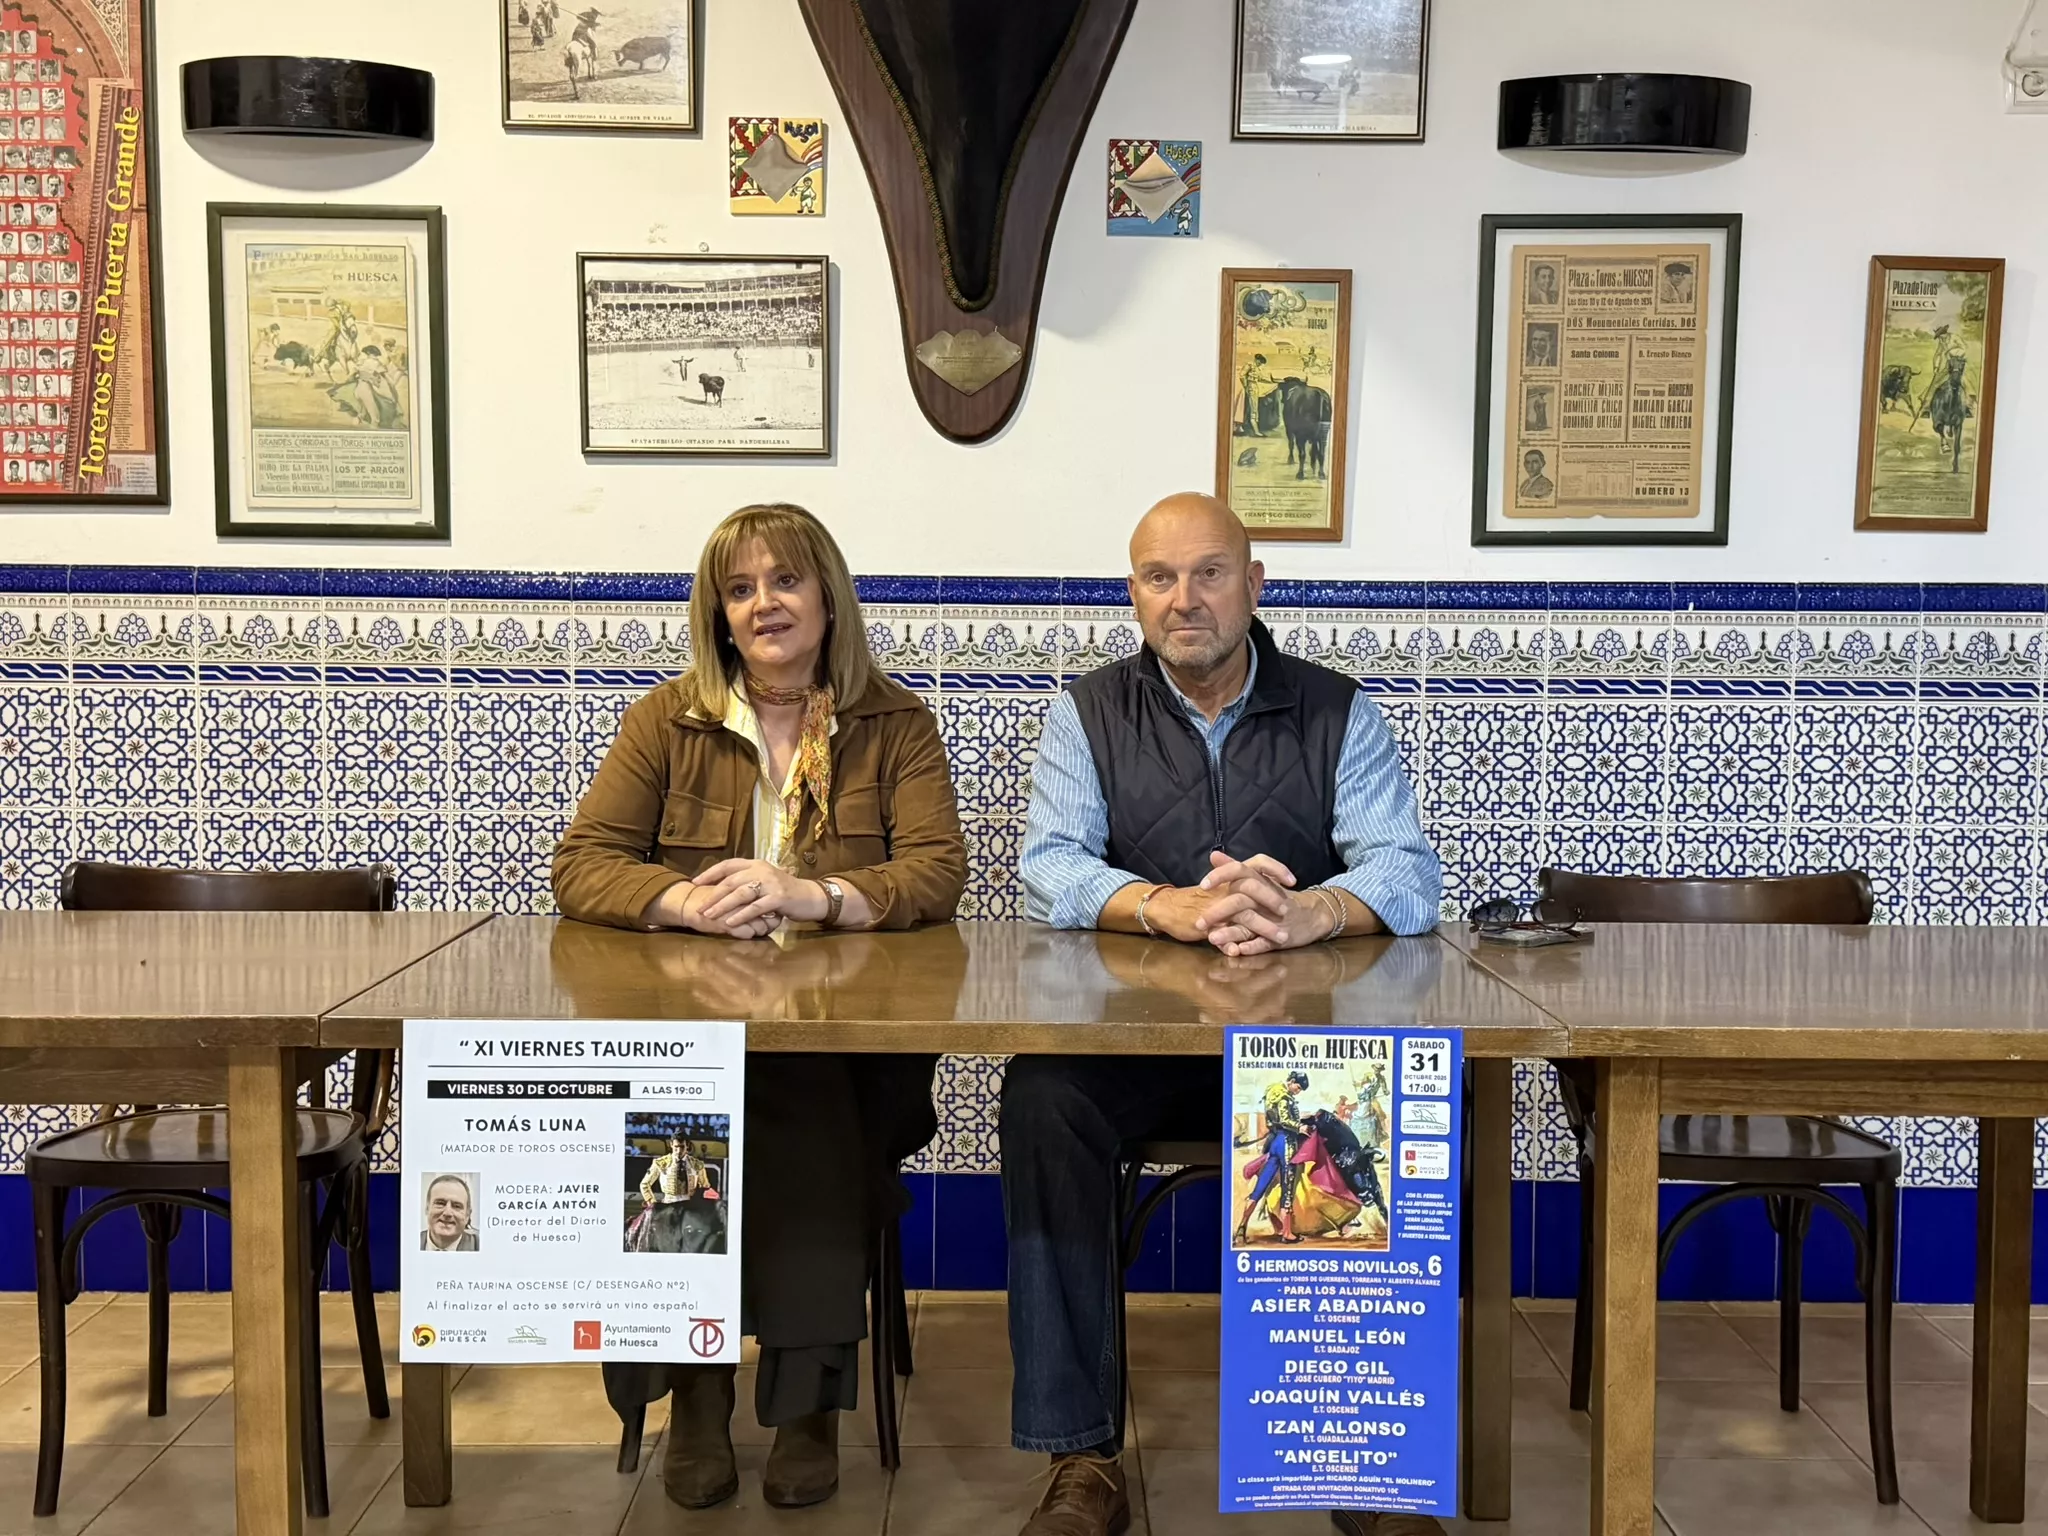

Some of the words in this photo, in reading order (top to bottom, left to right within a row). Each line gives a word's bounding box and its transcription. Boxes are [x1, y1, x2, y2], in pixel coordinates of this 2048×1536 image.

[105, 106, 141, 214] Grande
[1165, 144, 1198, 165] HUESCA
[95, 221, 130, 320] Puerta
[348, 273, 398, 282] HUESCA
[1568, 269, 1590, 287] Plaza
[1596, 269, 1616, 287] Toros
[1623, 269, 1654, 287] HUESCA
[1892, 300, 1936, 308] HUESCA
[1566, 317, 1582, 328] DOS
[1586, 317, 1640, 328] Monumentales
[1680, 317, 1696, 328] DOS
[92, 328, 119, 364] de
[1571, 350, 1590, 358] Santa
[1593, 350, 1619, 358] Coloma
[80, 370, 113, 479] Toreros
[335, 466, 350, 474] LOS
[355, 466, 366, 474] DE
[1636, 487, 1675, 496] NUMERO
[1680, 487, 1690, 496] 13
[500, 1041, 585, 1057] VIERNES
[1239, 1036, 1297, 1058] TOROS
[1302, 1043, 1319, 1059] en
[1325, 1038, 1388, 1060] HUESCA
[1238, 1061, 1284, 1069] SENSACIONAL
[1410, 1053, 1439, 1072] 31
[447, 1083, 504, 1095] VIERNES
[507, 1084, 524, 1096] 30
[527, 1084, 546, 1096] DE
[550, 1084, 613, 1096] OCTUBRE
[642, 1086, 649, 1095] A
[652, 1086, 672, 1095] LAS
[675, 1086, 703, 1096] 19:00
[1408, 1083, 1436, 1093] 17:00
[464, 1115, 532, 1132] TOMÁS
[539, 1119, 587, 1132] LUNA
[440, 1143, 496, 1155] (MATADOR
[500, 1144, 514, 1154] DE
[517, 1144, 556, 1154] TOROS
[560, 1143, 616, 1154] OSCENSE)
[495, 1184, 552, 1195] MODERA:
[557, 1184, 600, 1194] JAVIER
[498, 1197, 548, 1210] GARCÍA
[552, 1197, 597, 1210] ANTÓN
[486, 1216, 543, 1229] (Director
[546, 1216, 566, 1227] del
[570, 1216, 607, 1226] Diario
[512, 1232, 527, 1242] de
[532, 1231, 582, 1244] Huesca)
[1237, 1252, 1250, 1273] 6
[1255, 1260, 1339, 1273] HERMOSOS
[1343, 1260, 1423, 1276] NOVILLOS,
[1427, 1255, 1442, 1276] 6
[436, 1279, 464, 1290] PEÑA
[468, 1281, 512, 1291] TAURINA
[516, 1281, 568, 1291] OSCENSE
[596, 1279, 663, 1290] DESENGAÑO
[1284, 1286, 1312, 1295] PARA
[1315, 1286, 1336, 1295] LOS
[1339, 1286, 1393, 1296] ALUMNOS
[426, 1301, 438, 1310] Al
[443, 1301, 492, 1311] finalizar
[497, 1301, 507, 1311] el
[513, 1302, 540, 1311] acto
[544, 1303, 557, 1311] se
[562, 1300, 602, 1311] servirá
[624, 1301, 648, 1310] vino
[653, 1300, 699, 1313] español
[1251, 1299, 1311, 1313] ASIER
[1318, 1299, 1426, 1315] ABADIANO
[1328, 1315, 1360, 1324] OSCENSE
[440, 1328, 487, 1337] DIPUTACIÓN
[604, 1324, 671, 1336] Ayuntamiento
[1269, 1329, 1348, 1344] MANUEL
[1355, 1328, 1406, 1345] LEÓN
[604, 1338, 617, 1347] de
[620, 1338, 658, 1348] Huesca
[1285, 1360, 1348, 1374] DIEGO
[1355, 1361, 1389, 1375] GIL
[1314, 1375, 1342, 1383] CUBERO
[1368, 1376, 1395, 1385] MADRID
[1249, 1387, 1340, 1404] JOAQUÍN
[1347, 1389, 1426, 1407] VALLÉS
[1326, 1406, 1359, 1414] OSCENSE
[1267, 1421, 1315, 1434] IZAN
[1322, 1421, 1406, 1437] ALONSO
[1317, 1435, 1368, 1444] GUADALAJARA
[1275, 1450, 1397, 1465] "ANGELITO"
[1326, 1465, 1358, 1473] OSCENSE
